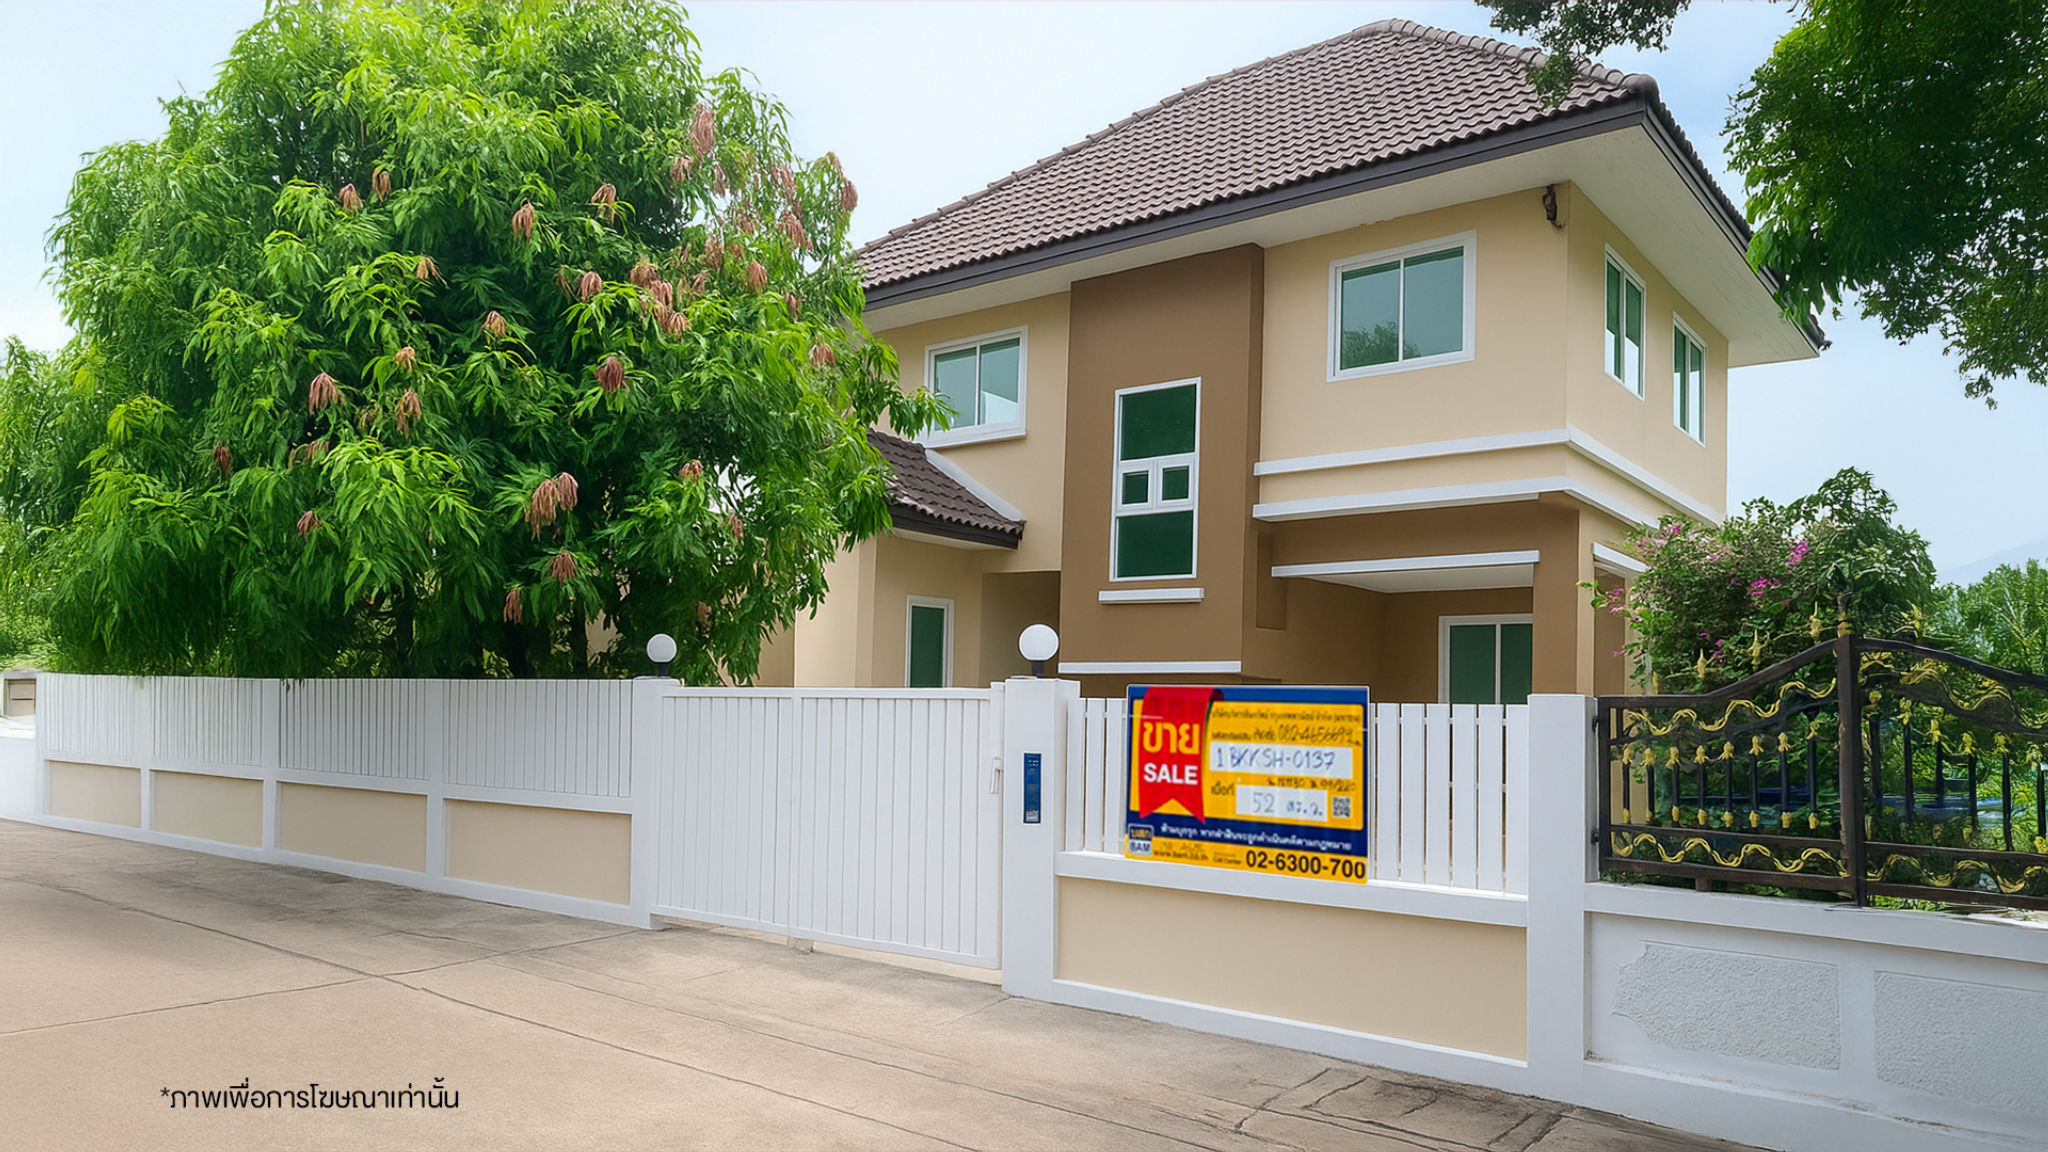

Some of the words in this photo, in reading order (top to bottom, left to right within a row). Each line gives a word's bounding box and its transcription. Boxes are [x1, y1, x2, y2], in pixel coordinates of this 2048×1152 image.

[1142, 721, 1200, 755] ขาย
[1143, 762, 1198, 785] SALE
[1252, 791, 1276, 813] 52
[1129, 841, 1151, 852] BAM
[1245, 849, 1366, 879] 02-6300-700
